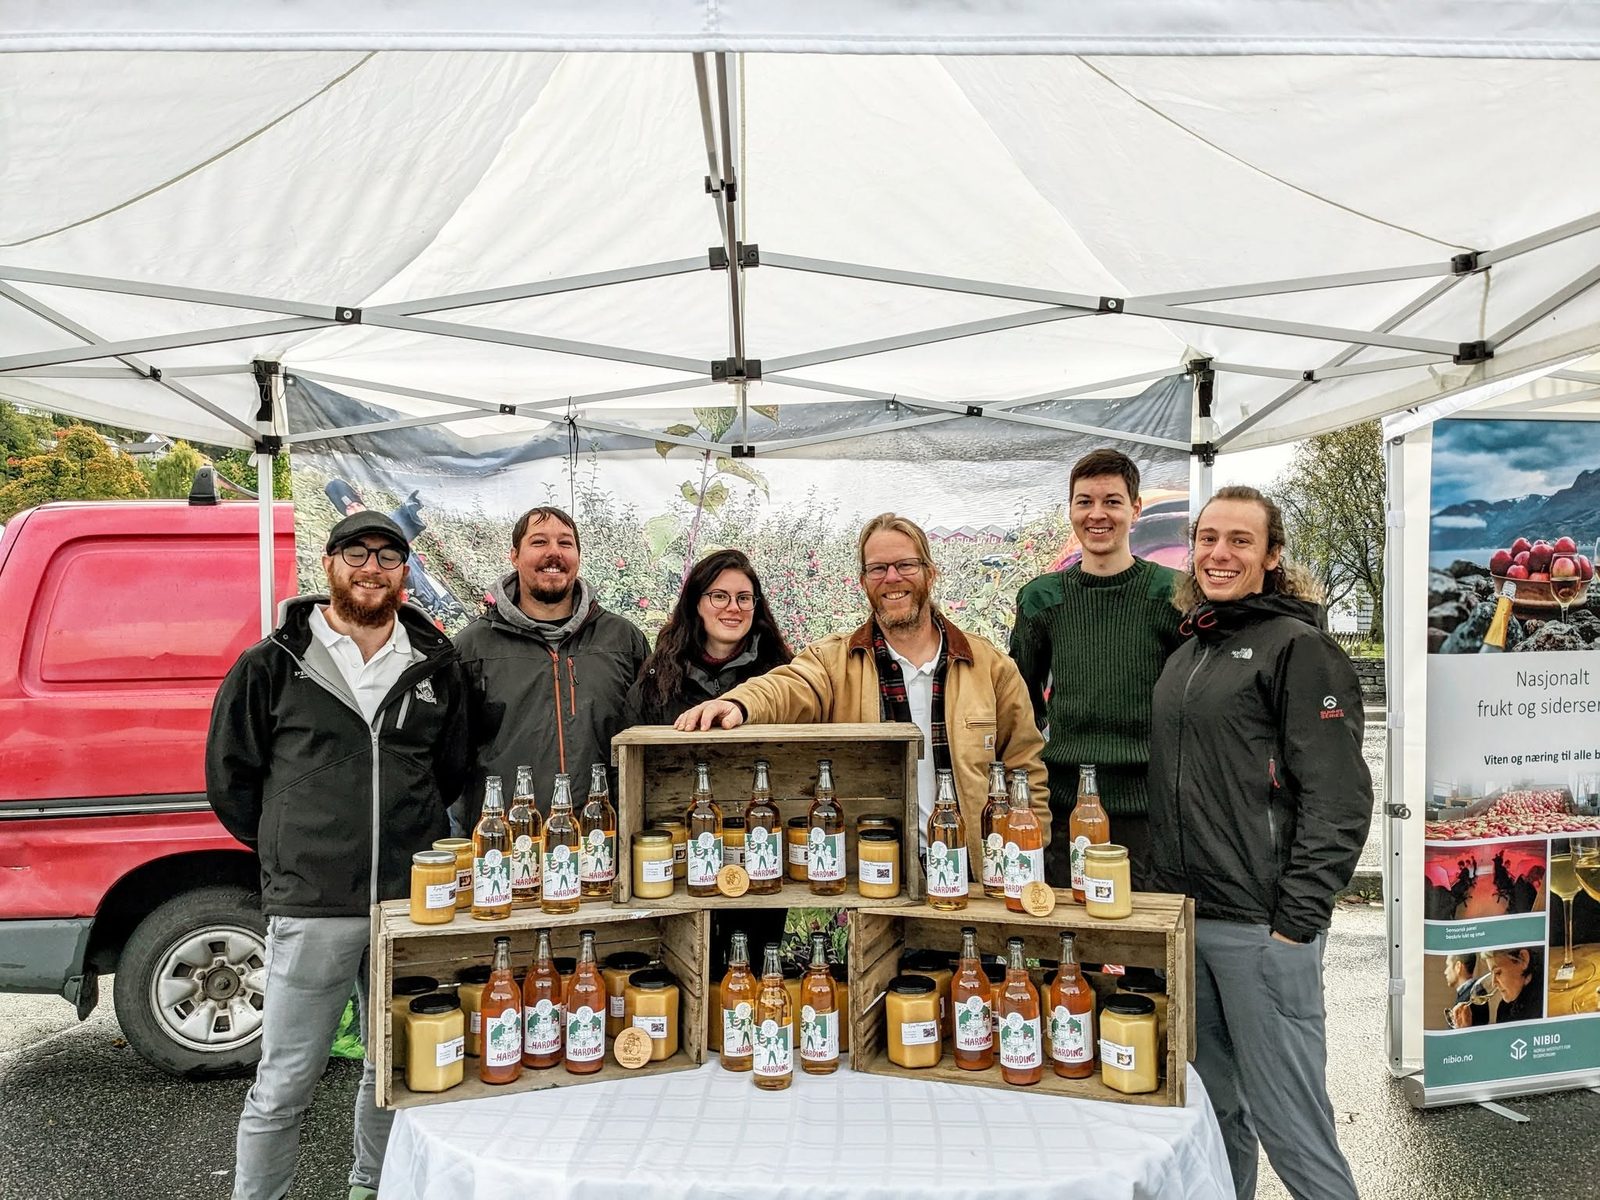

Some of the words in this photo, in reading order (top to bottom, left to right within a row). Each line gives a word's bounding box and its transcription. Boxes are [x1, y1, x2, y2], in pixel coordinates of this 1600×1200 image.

[1516, 668, 1590, 690] Nasjonalt
[1477, 699, 1513, 718] frukt
[1517, 701, 1536, 719] og
[1484, 754, 1509, 766] Viten
[1511, 755, 1523, 766] og
[1525, 752, 1559, 764] næring
[1561, 751, 1571, 761] til
[1573, 749, 1592, 760] alle
[753, 868, 778, 877] HARDING
[812, 869, 838, 878] HARDING
[553, 887, 578, 897] HARDING
[933, 885, 960, 893] HARDING
[532, 1039, 560, 1050] HARDING
[965, 1036, 991, 1046] HARDING
[1533, 1033, 1561, 1046] NIBIO
[573, 1047, 602, 1057] HARDING
[1055, 1047, 1083, 1057] HARDING
[1005, 1054, 1035, 1064] HARDING
[1443, 1054, 1474, 1064] nibio.no
[762, 1064, 789, 1073] HARDING
